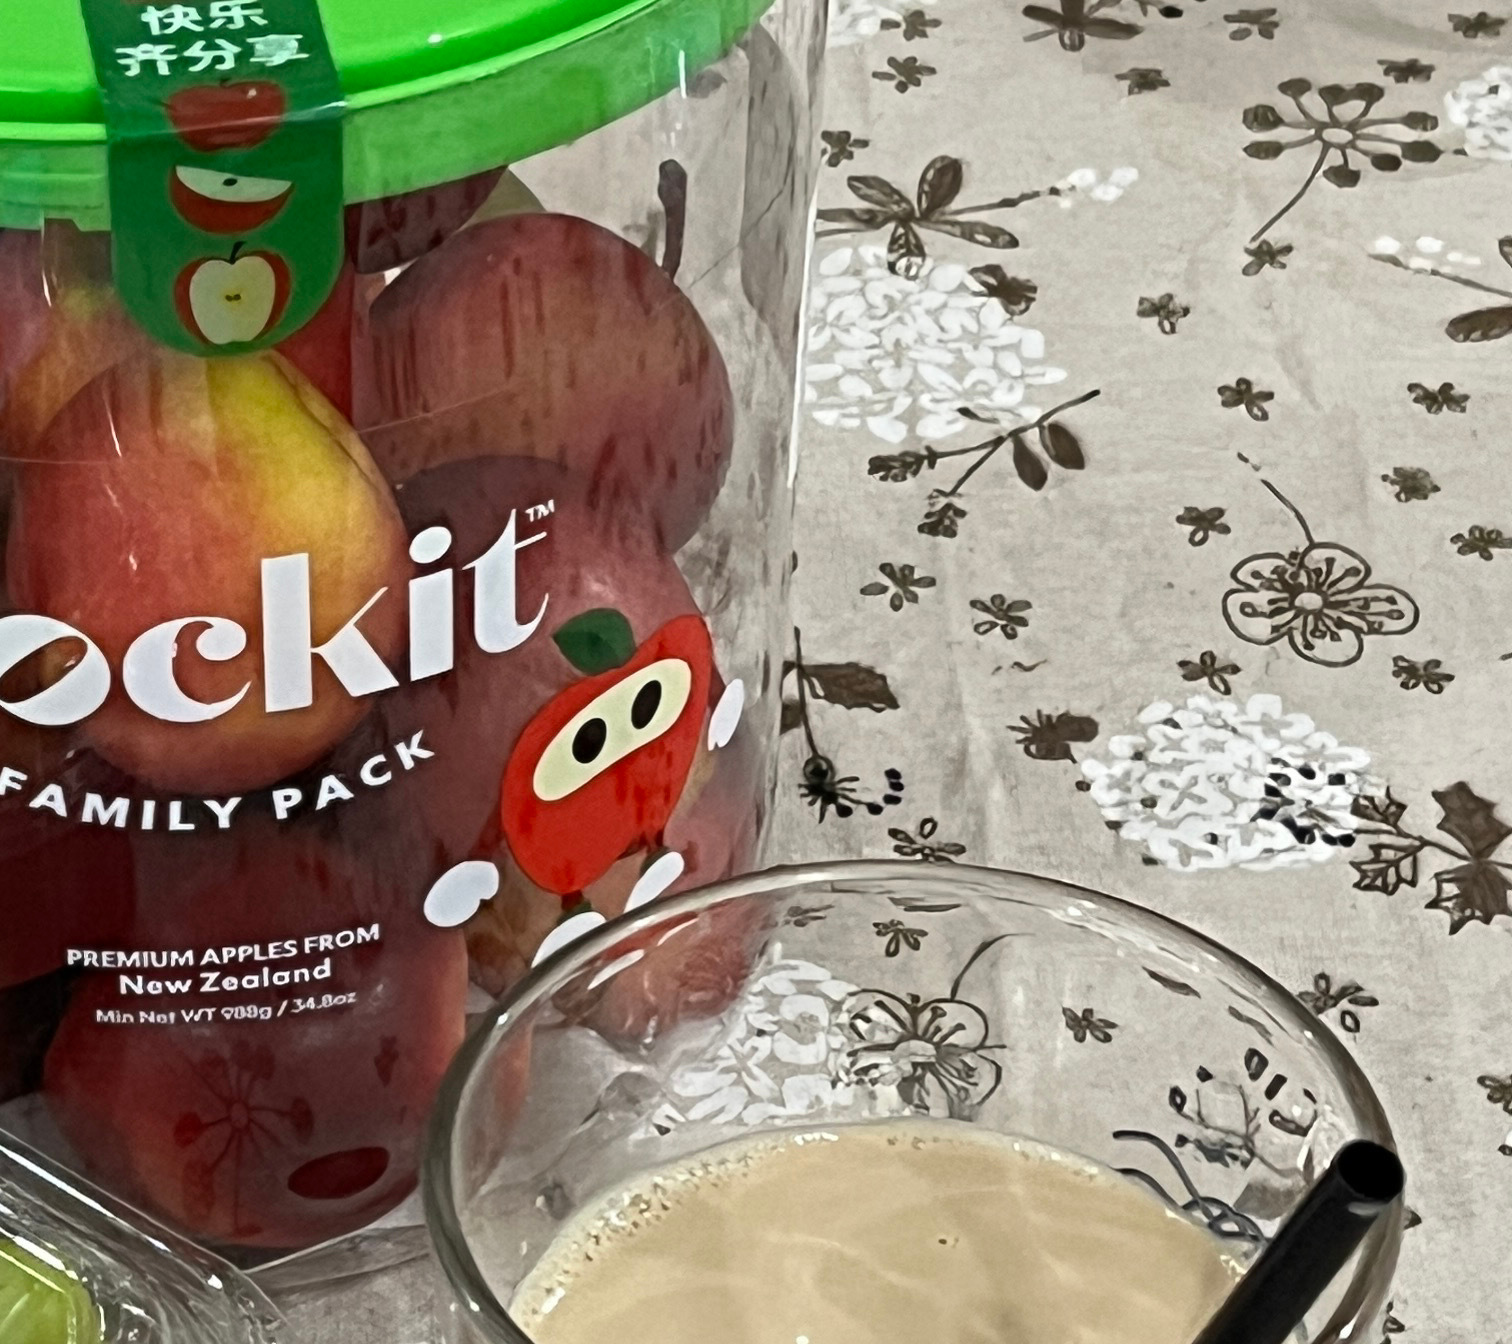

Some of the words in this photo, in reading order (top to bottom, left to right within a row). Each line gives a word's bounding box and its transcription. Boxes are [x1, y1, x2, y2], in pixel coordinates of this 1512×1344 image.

[115, 33, 309, 77] 齐分享
[272, 728, 437, 821] PACK
[67, 948, 194, 969] PREMIUM
[199, 939, 299, 966] APPLES
[303, 923, 380, 955] FROM
[119, 974, 193, 996] New
[199, 957, 332, 994] Zealand
[96, 1008, 135, 1024] Min
[139, 1009, 175, 1025] Net
[180, 1006, 217, 1023] WT
